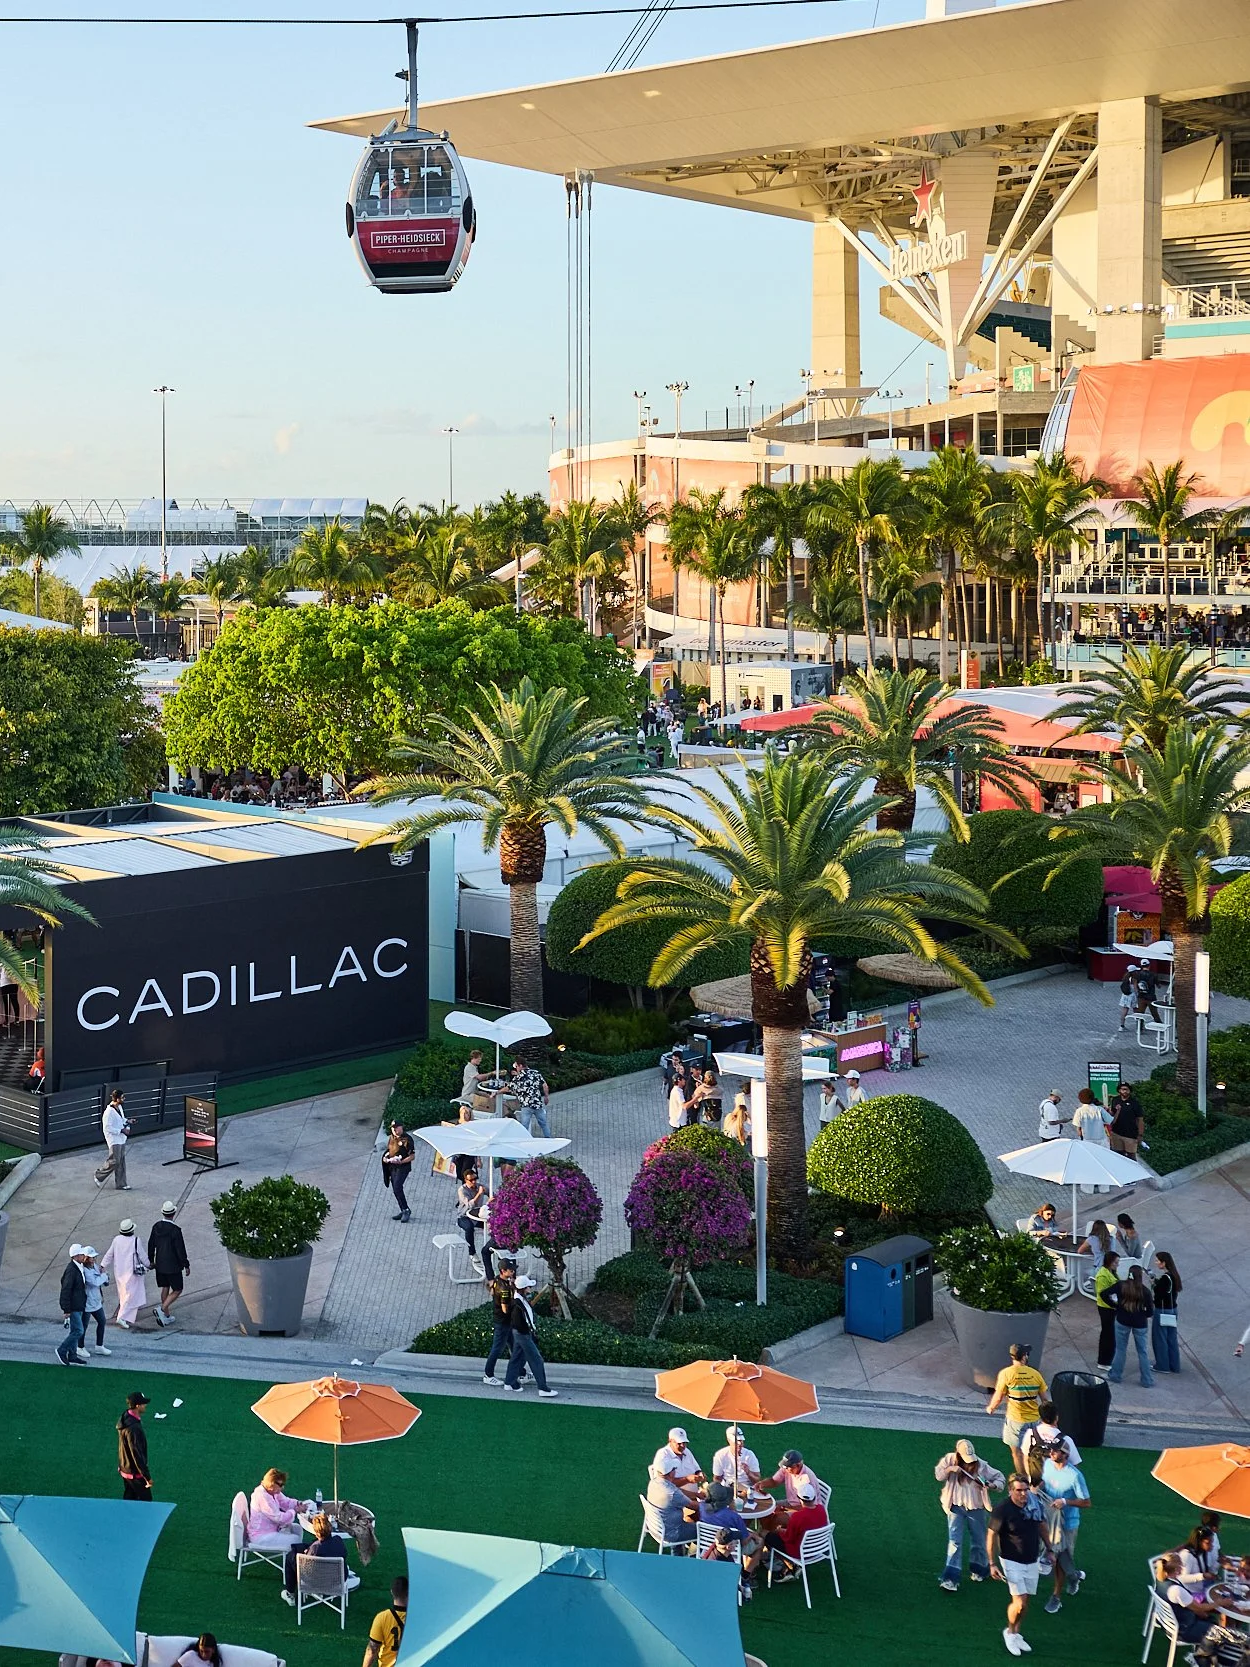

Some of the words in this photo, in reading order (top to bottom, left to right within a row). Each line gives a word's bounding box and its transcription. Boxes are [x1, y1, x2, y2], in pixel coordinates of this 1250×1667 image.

[375, 233, 441, 244] PIPER-HEIDSIECK
[890, 230, 967, 281] Heineken
[76, 937, 408, 1031] CADILLAC
